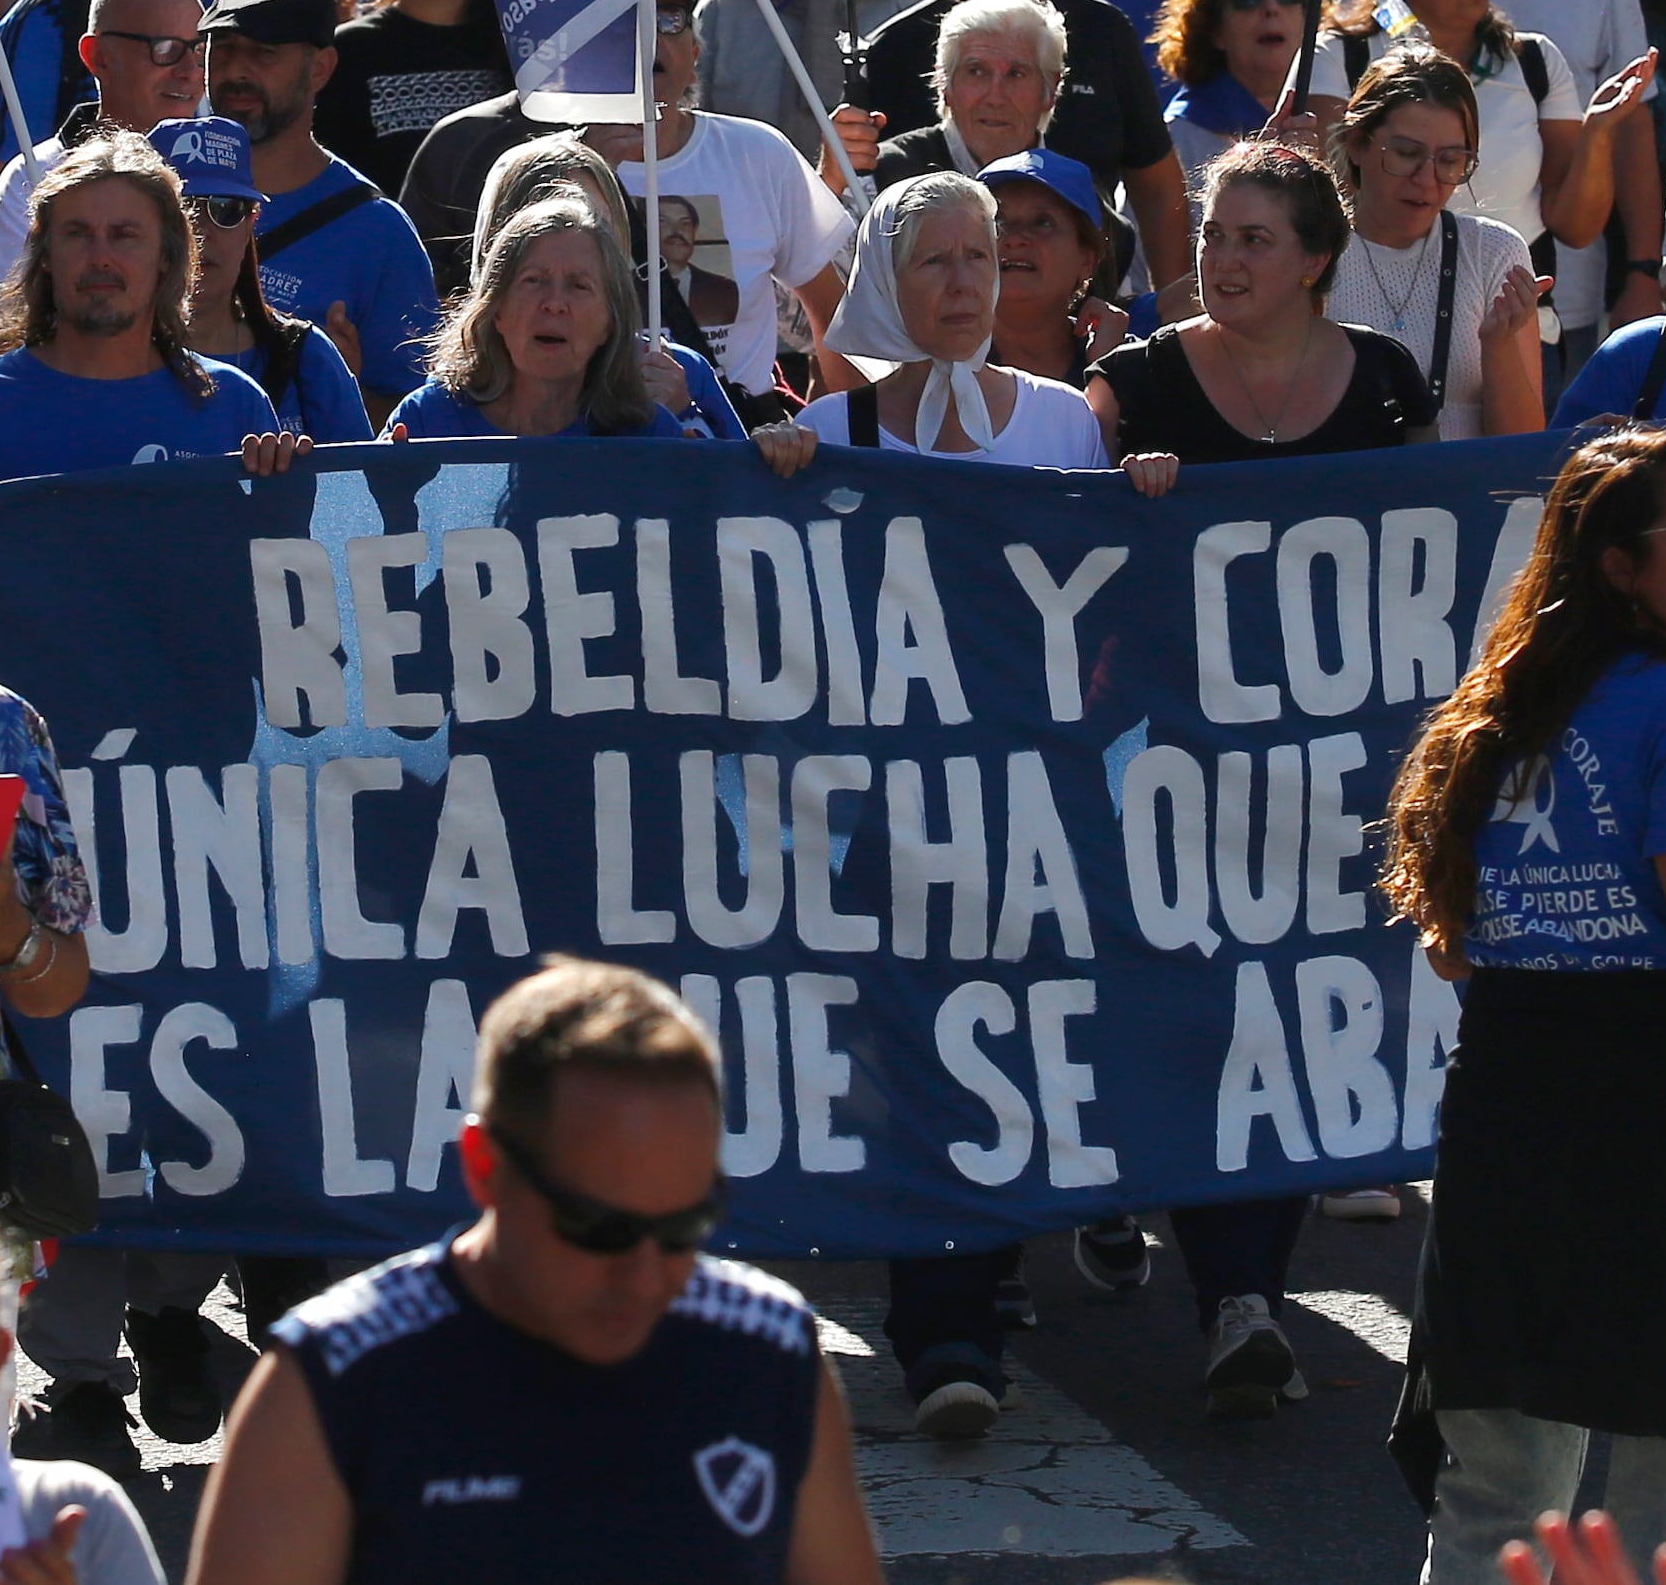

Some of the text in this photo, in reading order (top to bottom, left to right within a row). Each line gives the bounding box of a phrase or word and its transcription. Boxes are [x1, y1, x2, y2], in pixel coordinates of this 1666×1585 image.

[1072, 84, 1094, 94] FILA
[206, 148, 237, 162] DE PLAZA
[206, 157, 217, 166] DE
[260, 275, 299, 295] ADRES
[249, 485, 975, 728] REBELDÍA
[1003, 544, 1131, 723] Y
[1561, 727, 1620, 836] CORAJE
[71, 728, 529, 974] ÚNICA
[594, 749, 1095, 962] LUCHA
[1123, 732, 1369, 956] QUE
[1501, 868, 1521, 885] LA
[1524, 863, 1568, 884] ÚNICA
[1520, 889, 1600, 914] PIERDE
[1606, 886, 1637, 909] ES
[1523, 912, 1649, 943] ABANDONA
[69, 1001, 245, 1199] ES
[678, 972, 868, 1179] UE
[933, 978, 1119, 1188] SE
